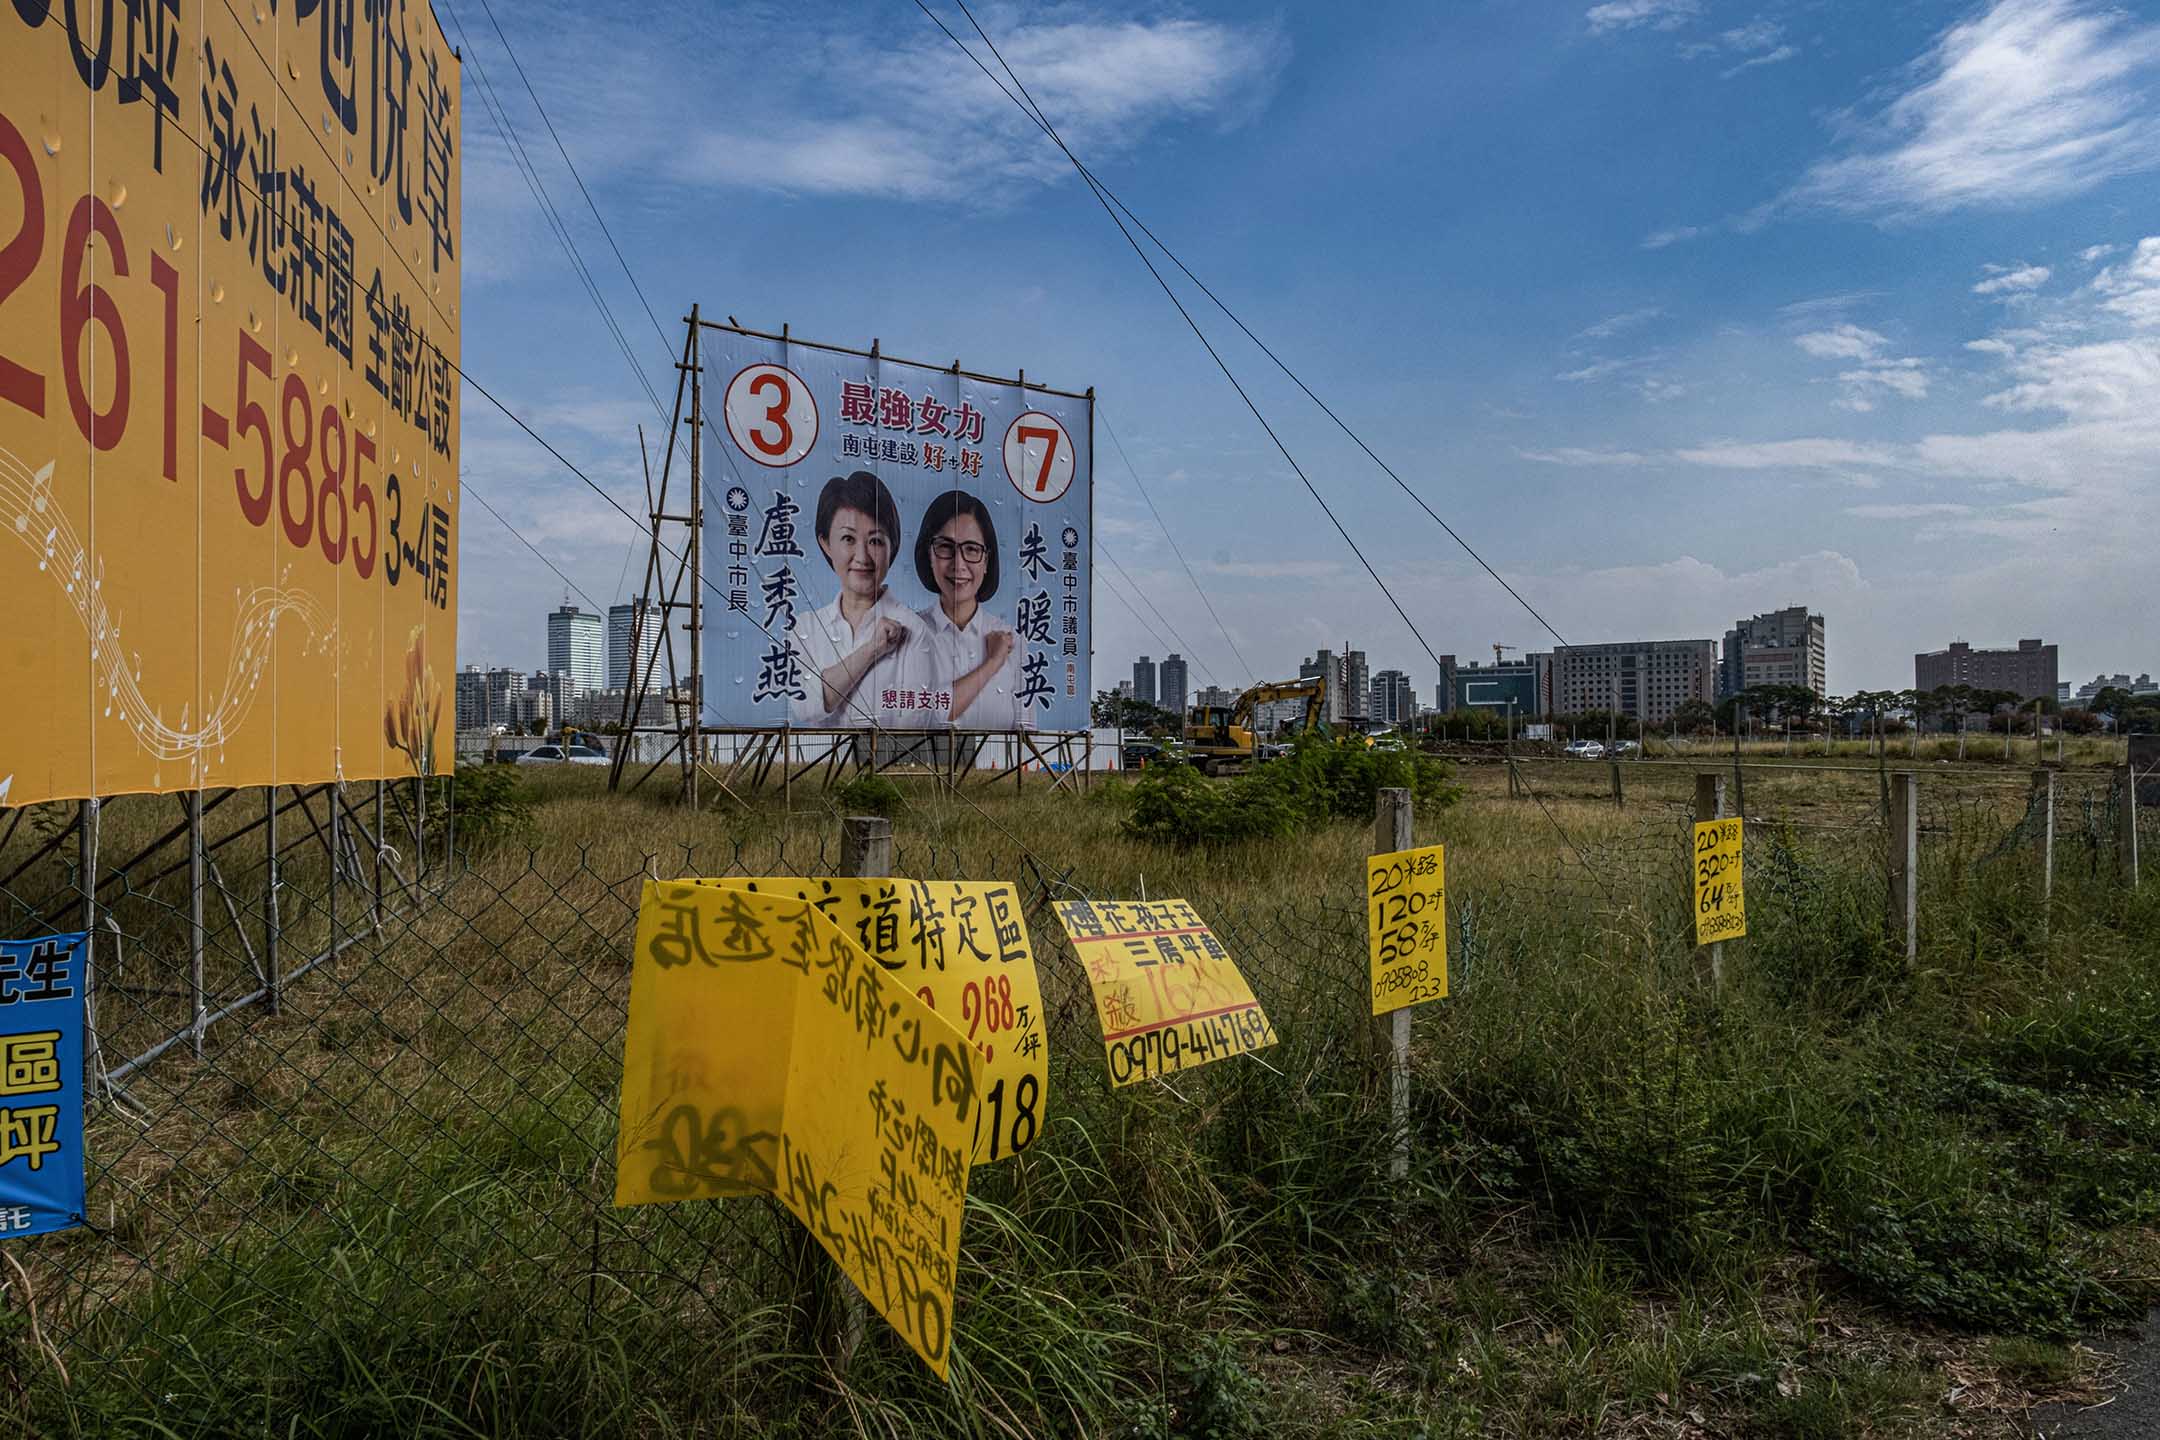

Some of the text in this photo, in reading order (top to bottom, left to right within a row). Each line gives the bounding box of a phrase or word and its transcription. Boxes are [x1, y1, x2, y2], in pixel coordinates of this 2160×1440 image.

[201, 36, 354, 371] 泳池莊園
[748, 373, 794, 456] 3
[839, 380, 985, 443] 最強女力
[841, 432, 917, 466] 南屯建設
[1016, 425, 1060, 493] 7
[726, 514, 749, 613] 臺中市長
[751, 490, 807, 705] 盧秀燕
[1014, 521, 1057, 710] 朱暖英
[1062, 551, 1078, 658] 臺中市議員
[880, 688, 951, 711] 懇請支持
[1372, 853, 1438, 897] 20米路
[1378, 888, 1443, 931] 120坪
[1109, 1008, 1266, 1083] 0979-414769
[971, 1073, 1039, 1162] 18
